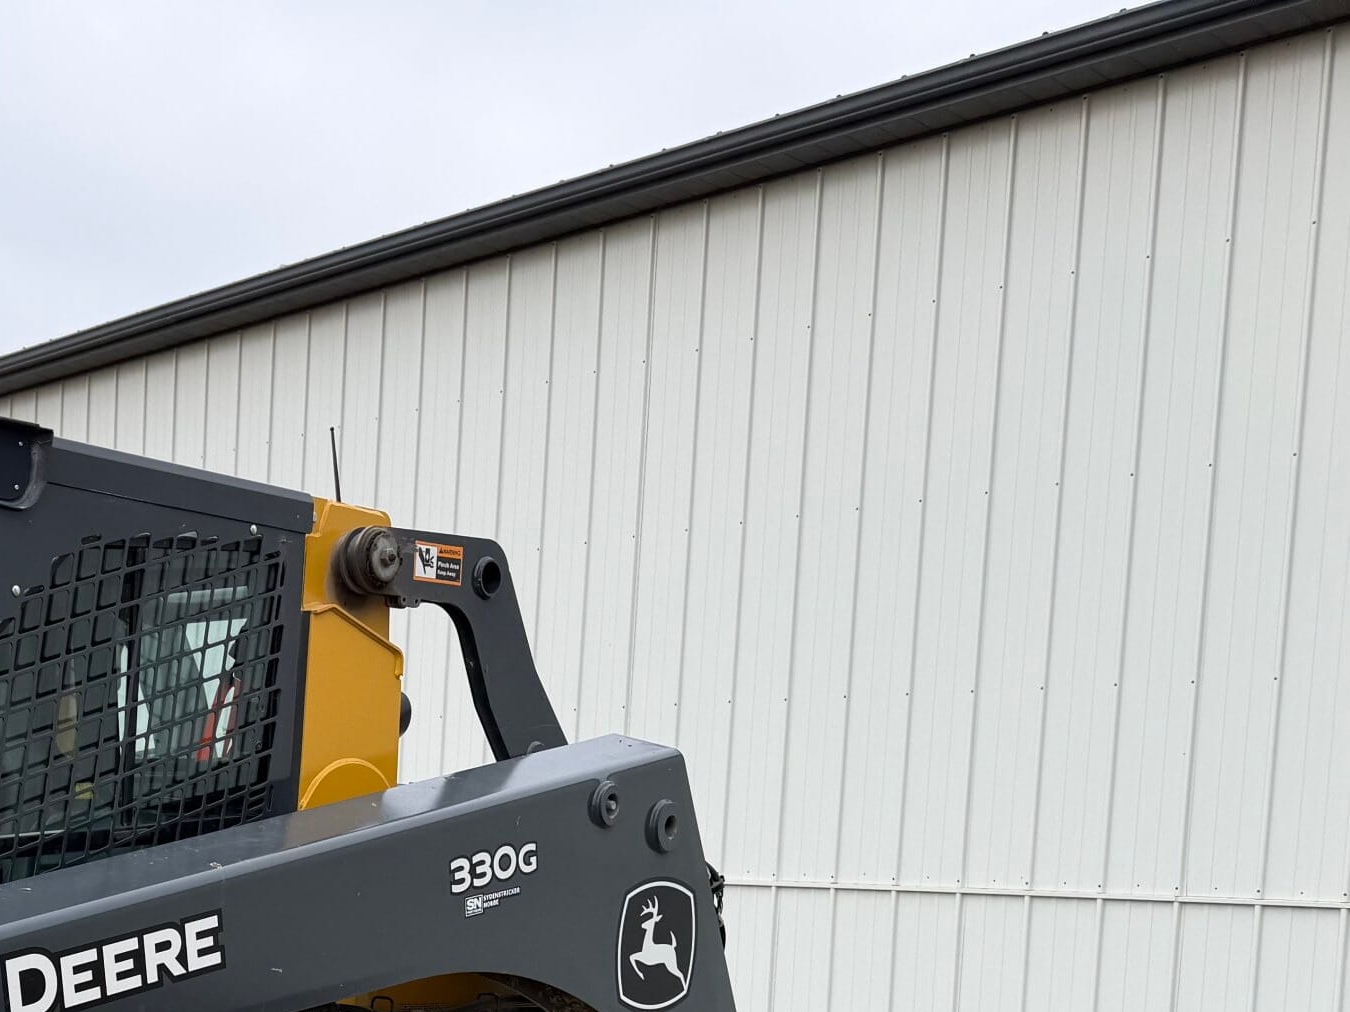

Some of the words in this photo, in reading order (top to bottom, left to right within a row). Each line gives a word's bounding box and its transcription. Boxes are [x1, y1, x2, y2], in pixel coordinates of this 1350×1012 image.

[438, 561, 450, 569] Pinch
[450, 562, 460, 570] Area
[450, 842, 538, 894] 330G
[466, 896, 482, 911] SN
